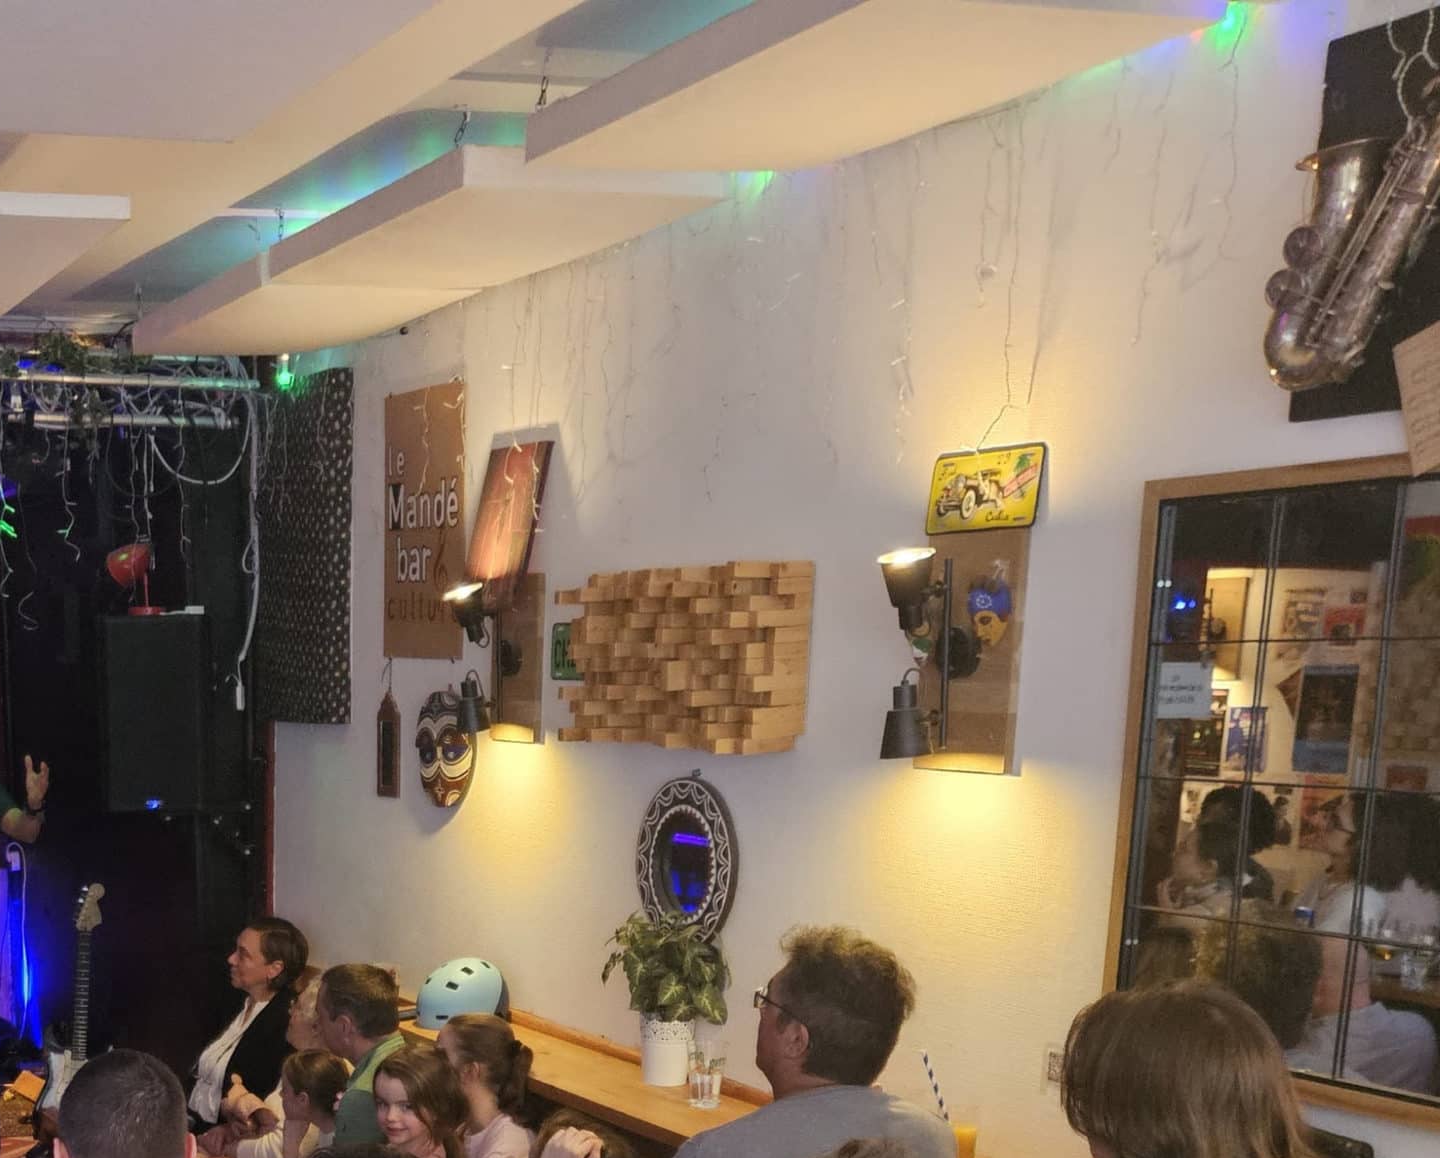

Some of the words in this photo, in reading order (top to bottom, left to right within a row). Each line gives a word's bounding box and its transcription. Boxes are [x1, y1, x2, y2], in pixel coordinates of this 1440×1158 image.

[388, 446, 405, 476] le
[388, 478, 459, 529] Mandé
[396, 536, 432, 582] bar
